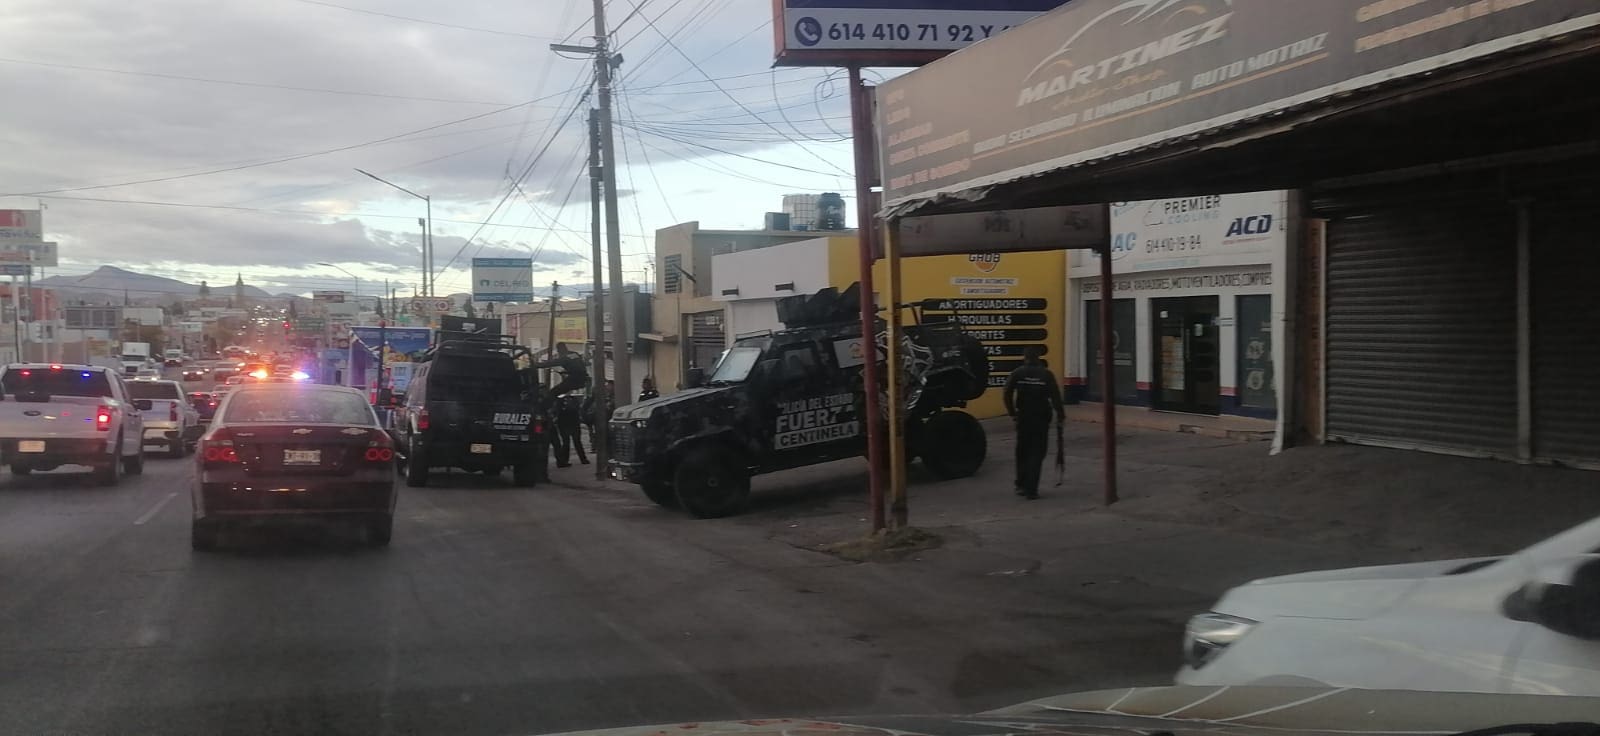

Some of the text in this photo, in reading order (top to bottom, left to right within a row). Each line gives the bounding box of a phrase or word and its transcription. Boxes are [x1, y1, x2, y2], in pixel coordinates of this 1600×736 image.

[828, 23, 866, 41] 614
[872, 24, 910, 41] 410
[917, 25, 938, 41] 71
[948, 25, 973, 42] 92
[1016, 12, 1234, 108] MARTINEZ
[1246, 32, 1329, 72] MOTRIZ
[1164, 195, 1222, 214] PREMIER
[1167, 209, 1220, 224] COOLING
[492, 412, 532, 425] RURALES
[779, 424, 854, 447] CENTINELA
